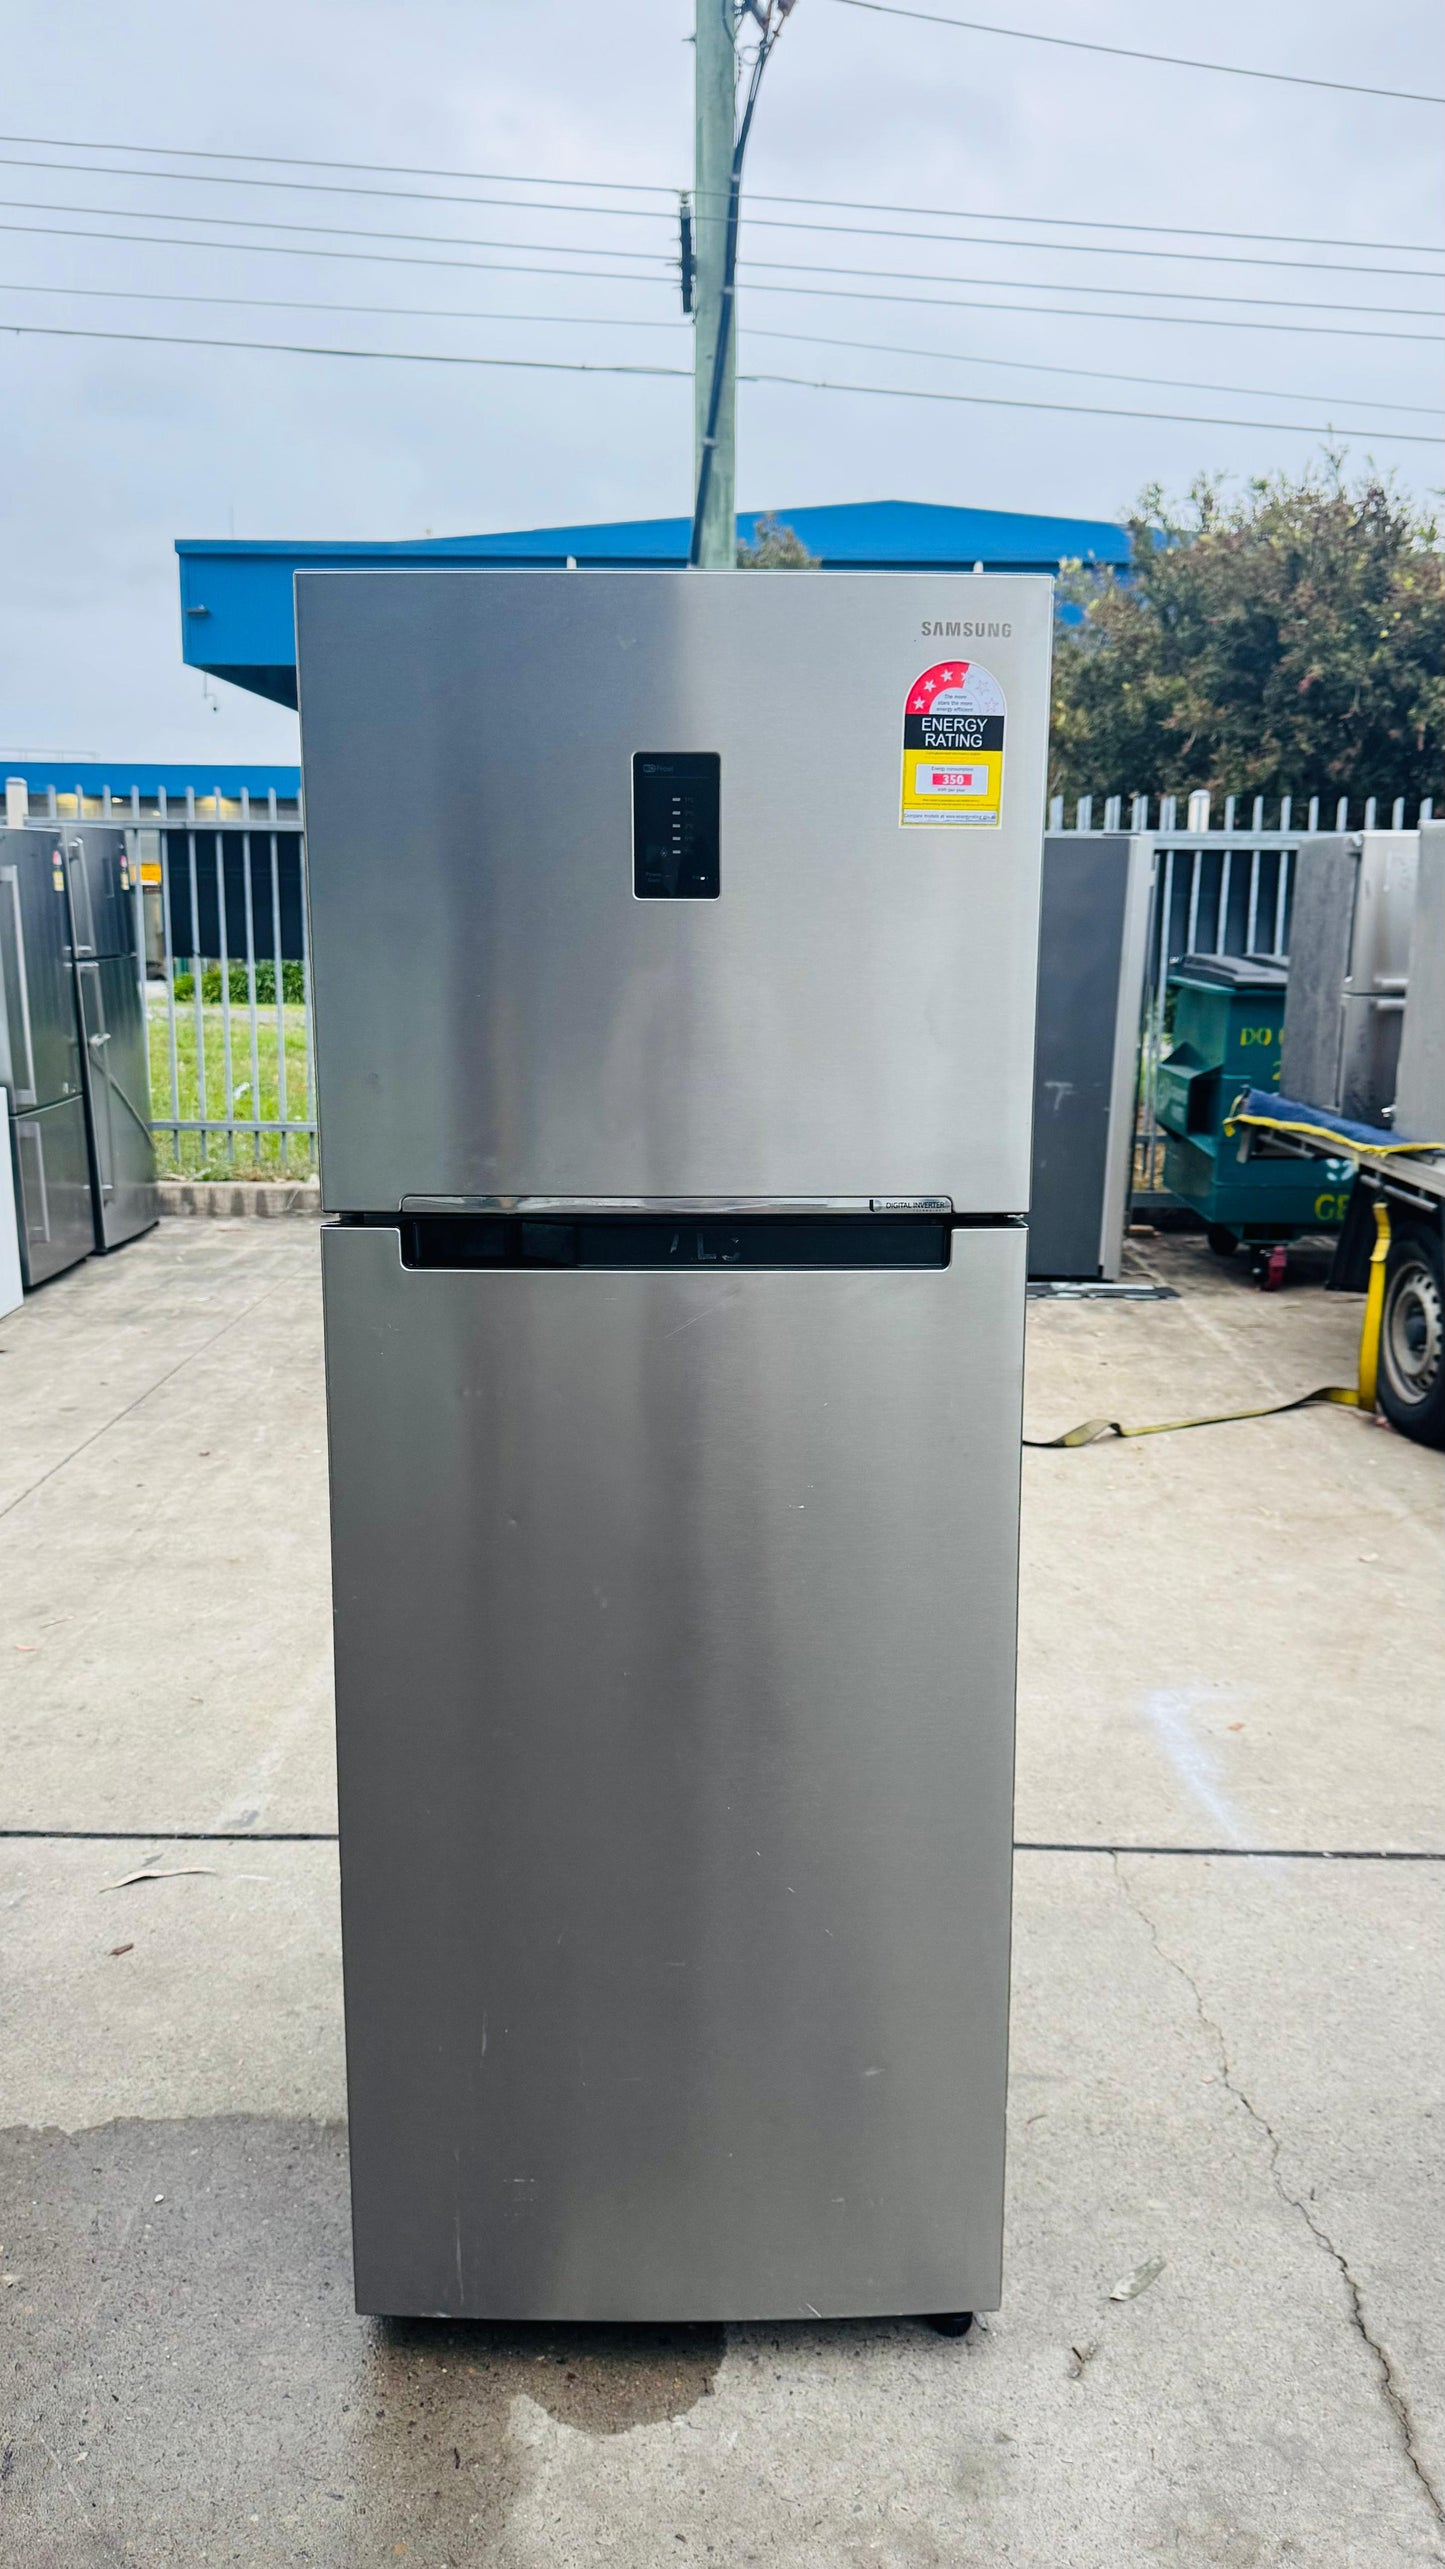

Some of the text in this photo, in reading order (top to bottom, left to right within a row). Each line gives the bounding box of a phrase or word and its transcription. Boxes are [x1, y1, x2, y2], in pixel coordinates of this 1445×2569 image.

[921, 621, 1013, 638] SAMSUNG
[921, 717, 988, 732] ENERGY
[924, 733, 983, 748] RATING
[942, 774, 964, 785] 350
[1240, 1028, 1272, 1046] DO
[912, 1201, 945, 1209] INVERTER
